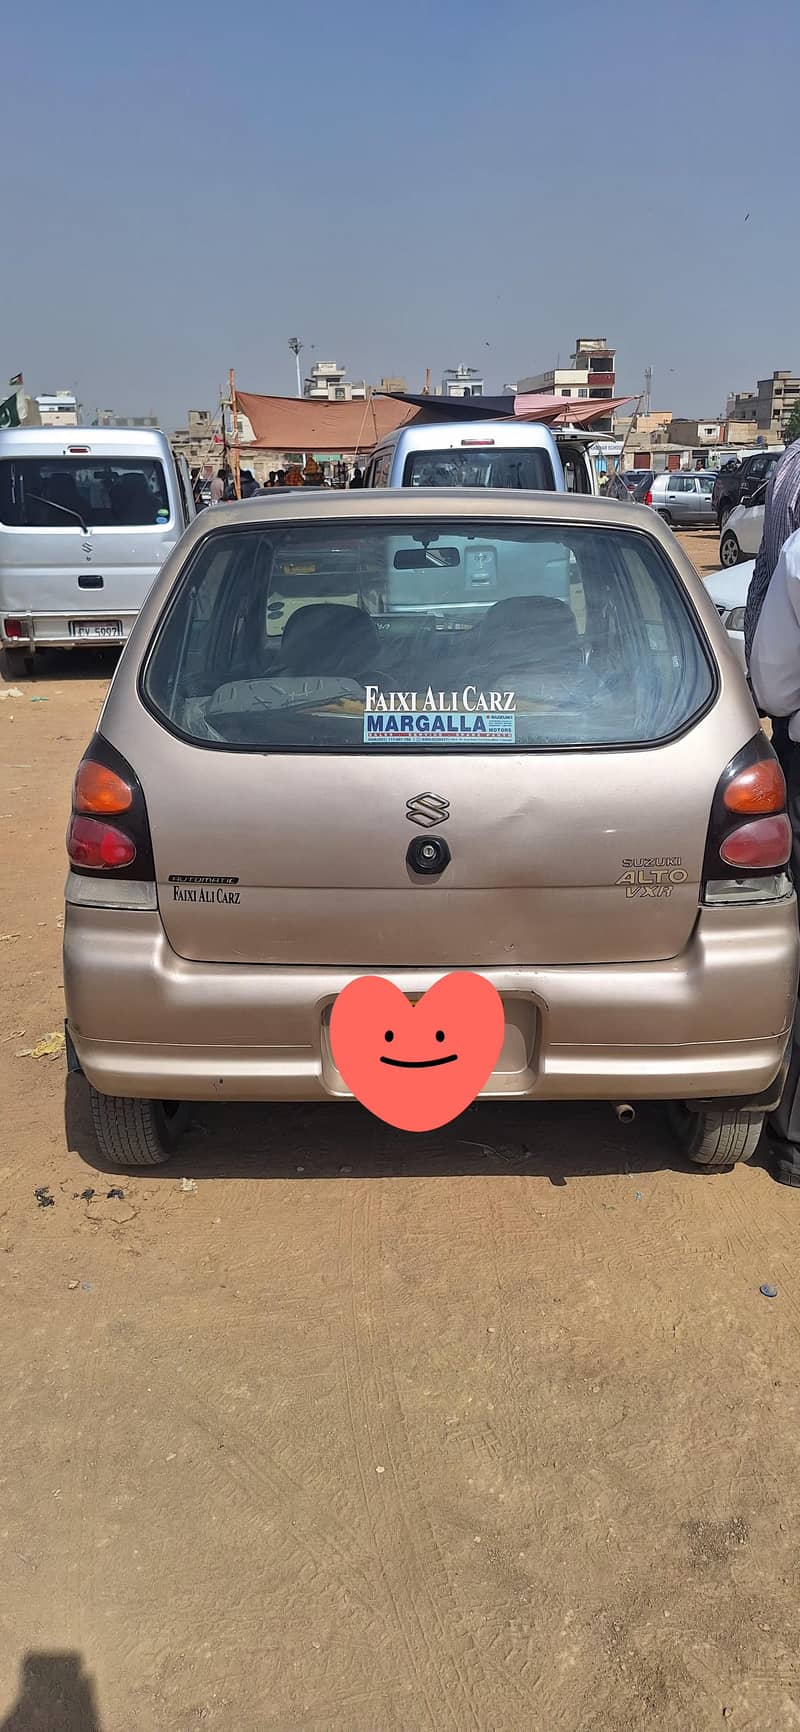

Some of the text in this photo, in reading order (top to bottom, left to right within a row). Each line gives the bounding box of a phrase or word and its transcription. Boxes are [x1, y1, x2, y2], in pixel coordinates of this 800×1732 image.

[364, 685, 517, 712] FAIXI ALI CARZ
[367, 715, 487, 732] MARGALLA
[622, 856, 682, 868] SUZUKI
[615, 868, 689, 886] ALTO
[173, 885, 241, 904] FAIXI ALI CARZ
[625, 885, 674, 898] VXR
